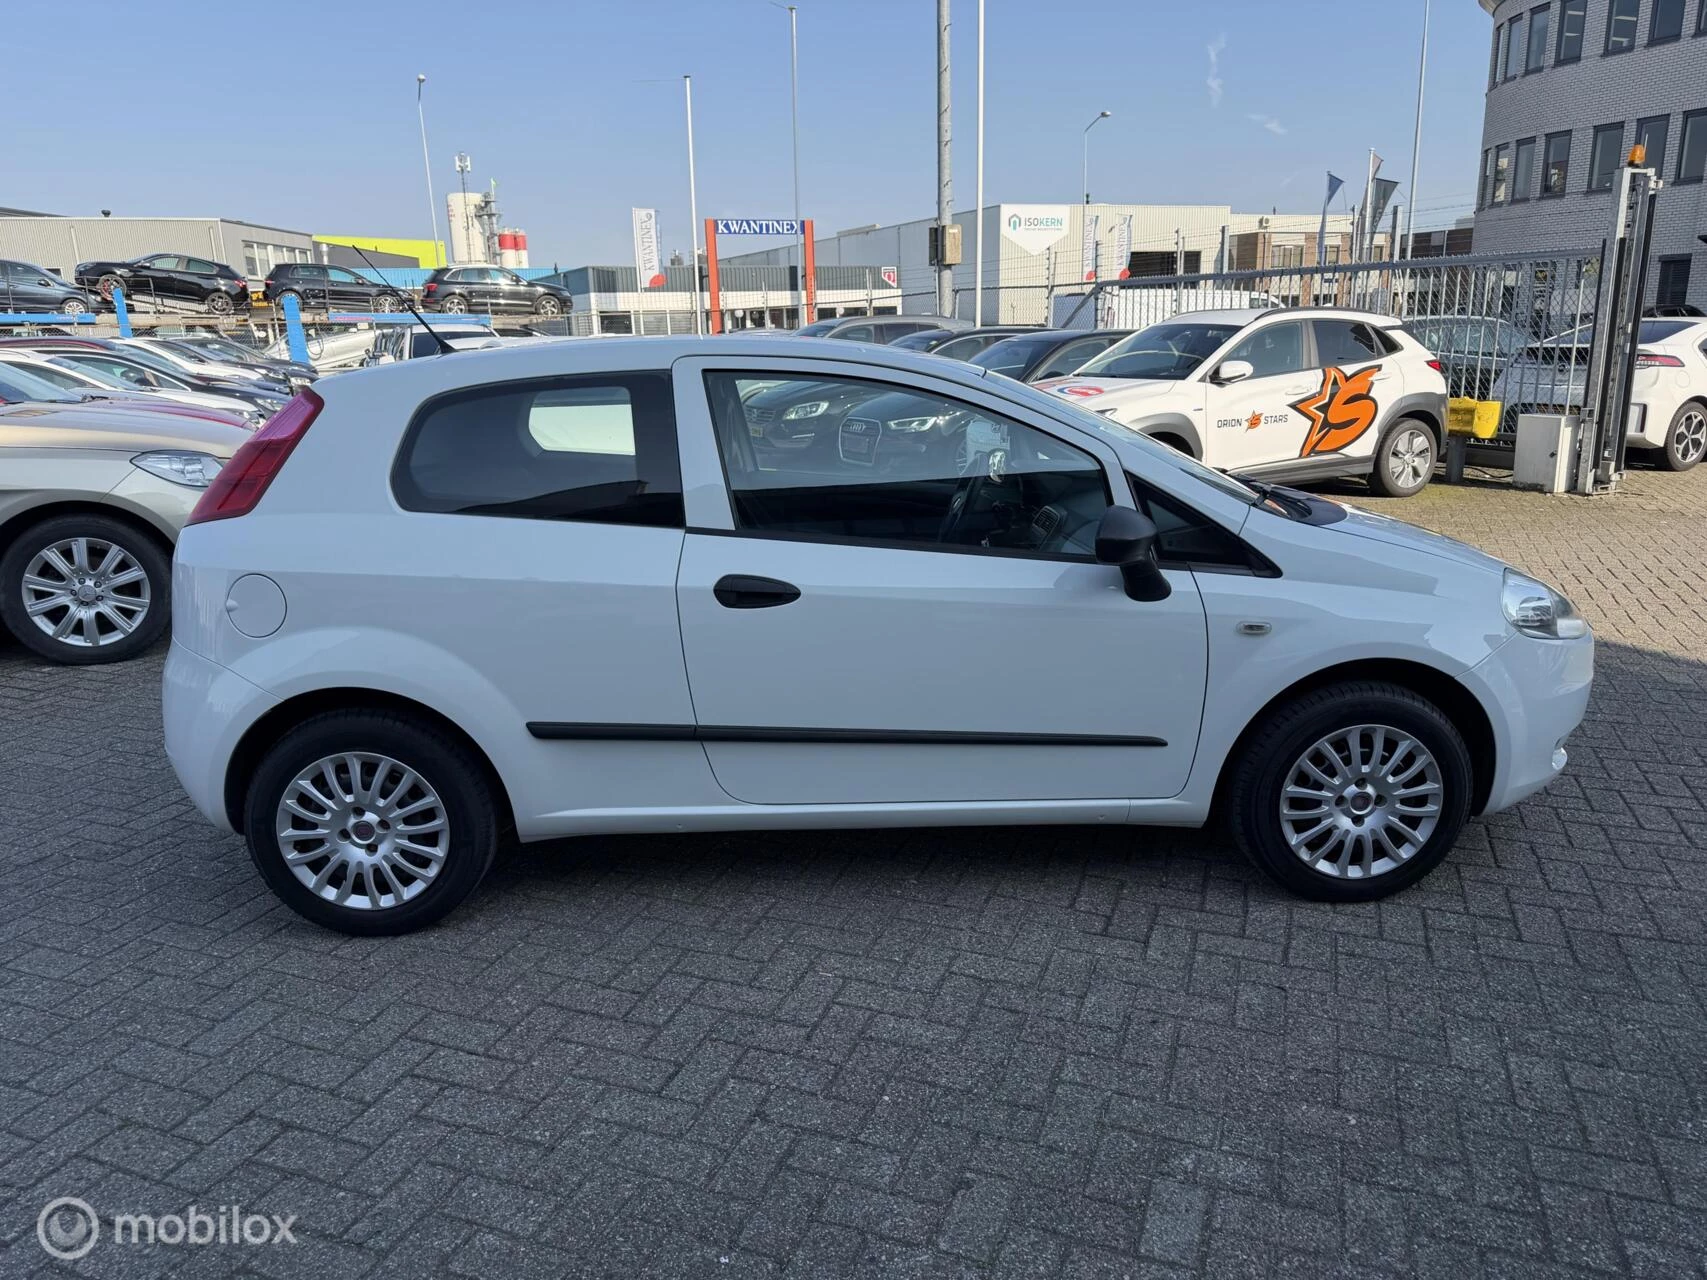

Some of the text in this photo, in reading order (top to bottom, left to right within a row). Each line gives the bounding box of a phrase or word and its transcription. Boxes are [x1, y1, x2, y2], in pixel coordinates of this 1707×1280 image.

[1024, 217, 1063, 227] ISOKERN
[1217, 418, 1243, 429] ORION
[1264, 414, 1289, 425] STARS
